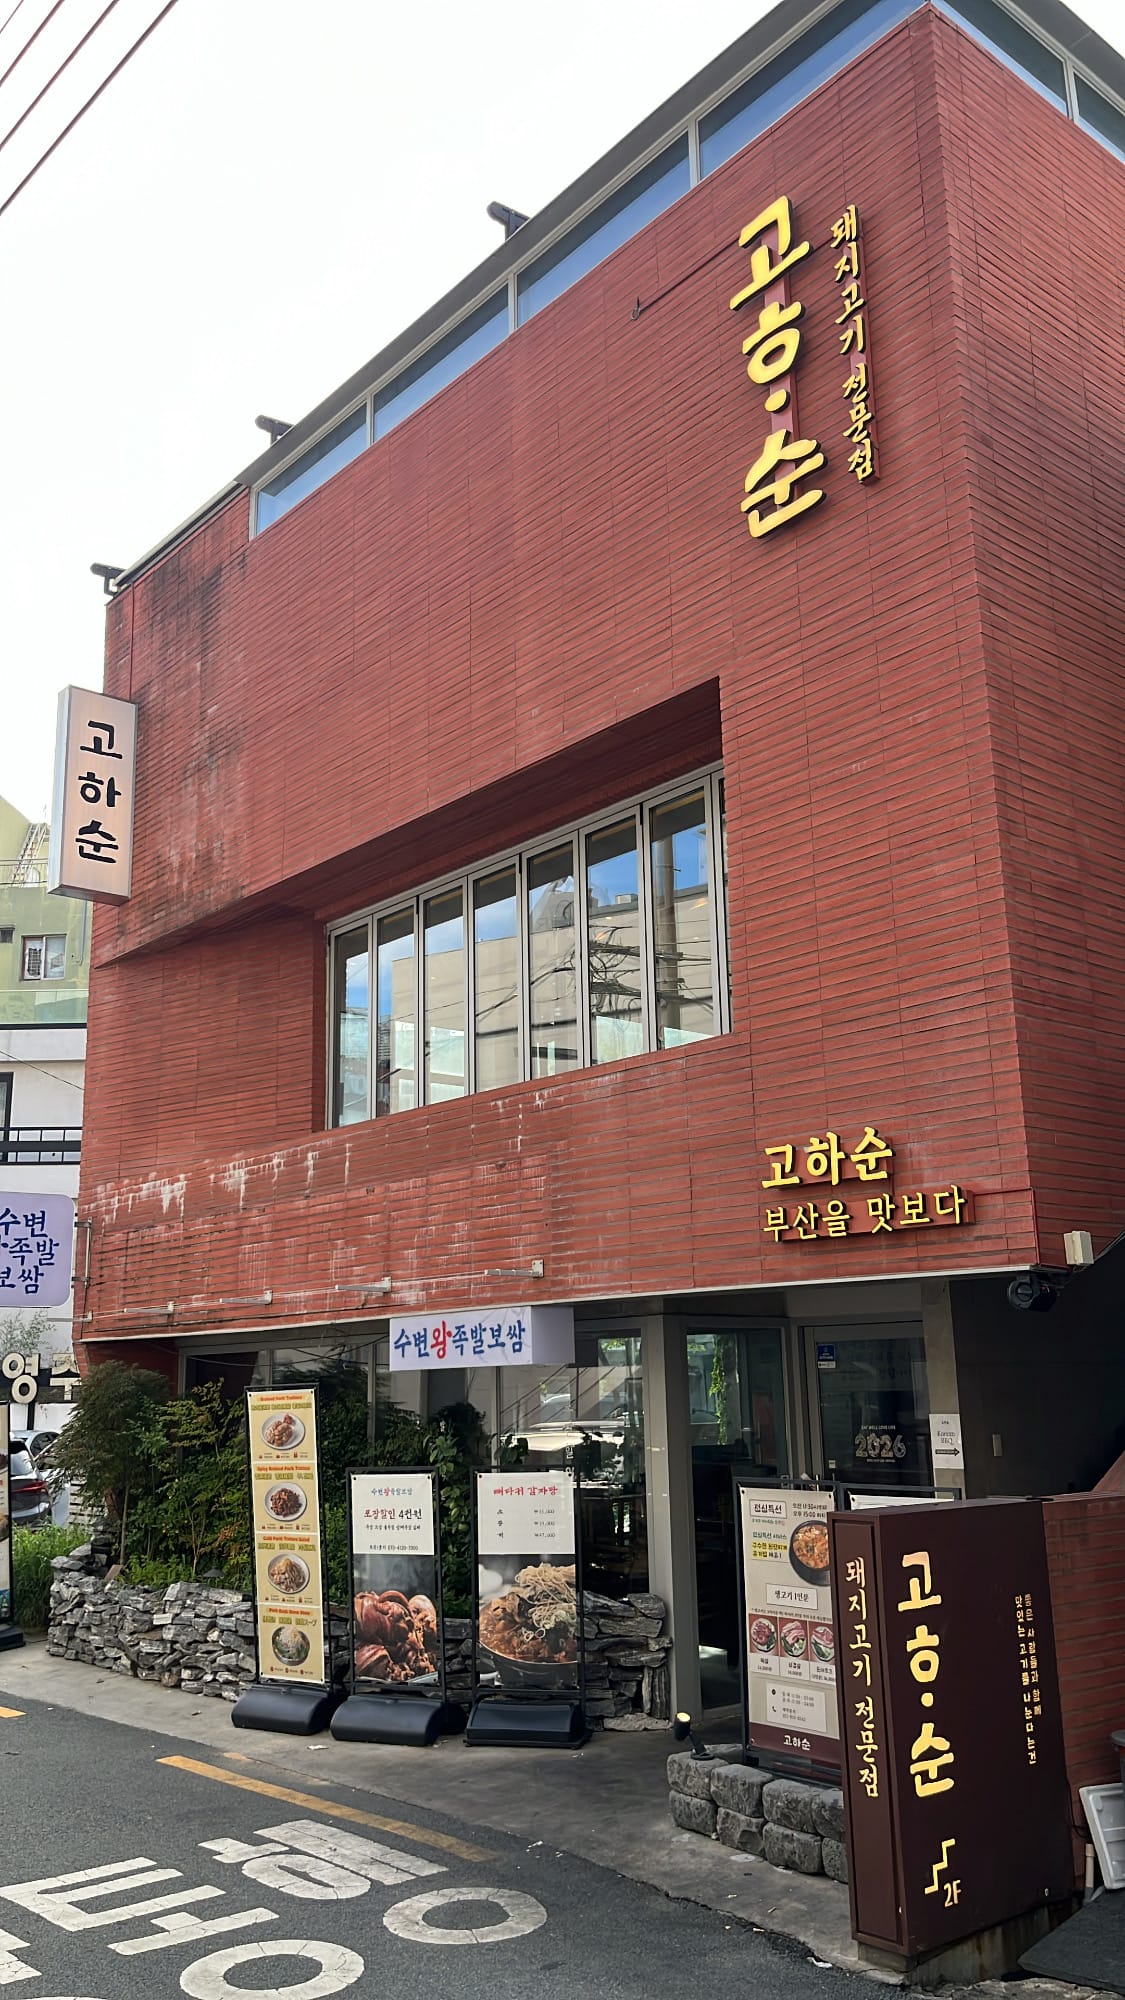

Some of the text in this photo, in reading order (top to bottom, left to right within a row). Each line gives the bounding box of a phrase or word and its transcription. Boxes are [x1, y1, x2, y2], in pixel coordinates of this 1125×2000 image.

[830, 204, 875, 484] 돼지고기 전문점
[75, 720, 123, 864] 고하순
[761, 1126, 894, 1189] 고하순
[0, 1207, 48, 1238] 수변
[762, 1184, 967, 1243] 부산을 맛보다
[0, 1238, 60, 1267] 족발
[0, 1265, 45, 1295] 보쌈
[393, 1319, 526, 1360] 수변왕족발보쌈
[527, 1485, 558, 1496] 감자탕
[754, 1503, 783, 1515] 점심특선
[364, 1508, 422, 1520] 포장할인 4천원
[1014, 1594, 1026, 1638] 맛있는
[845, 1556, 879, 1798] 돼지고기 전문점
[1019, 1643, 1030, 1686] 고기를
[783, 1735, 811, 1751] 고하순
[0, 1819, 547, 2000] 통행
[943, 1878, 962, 1908] 2F
